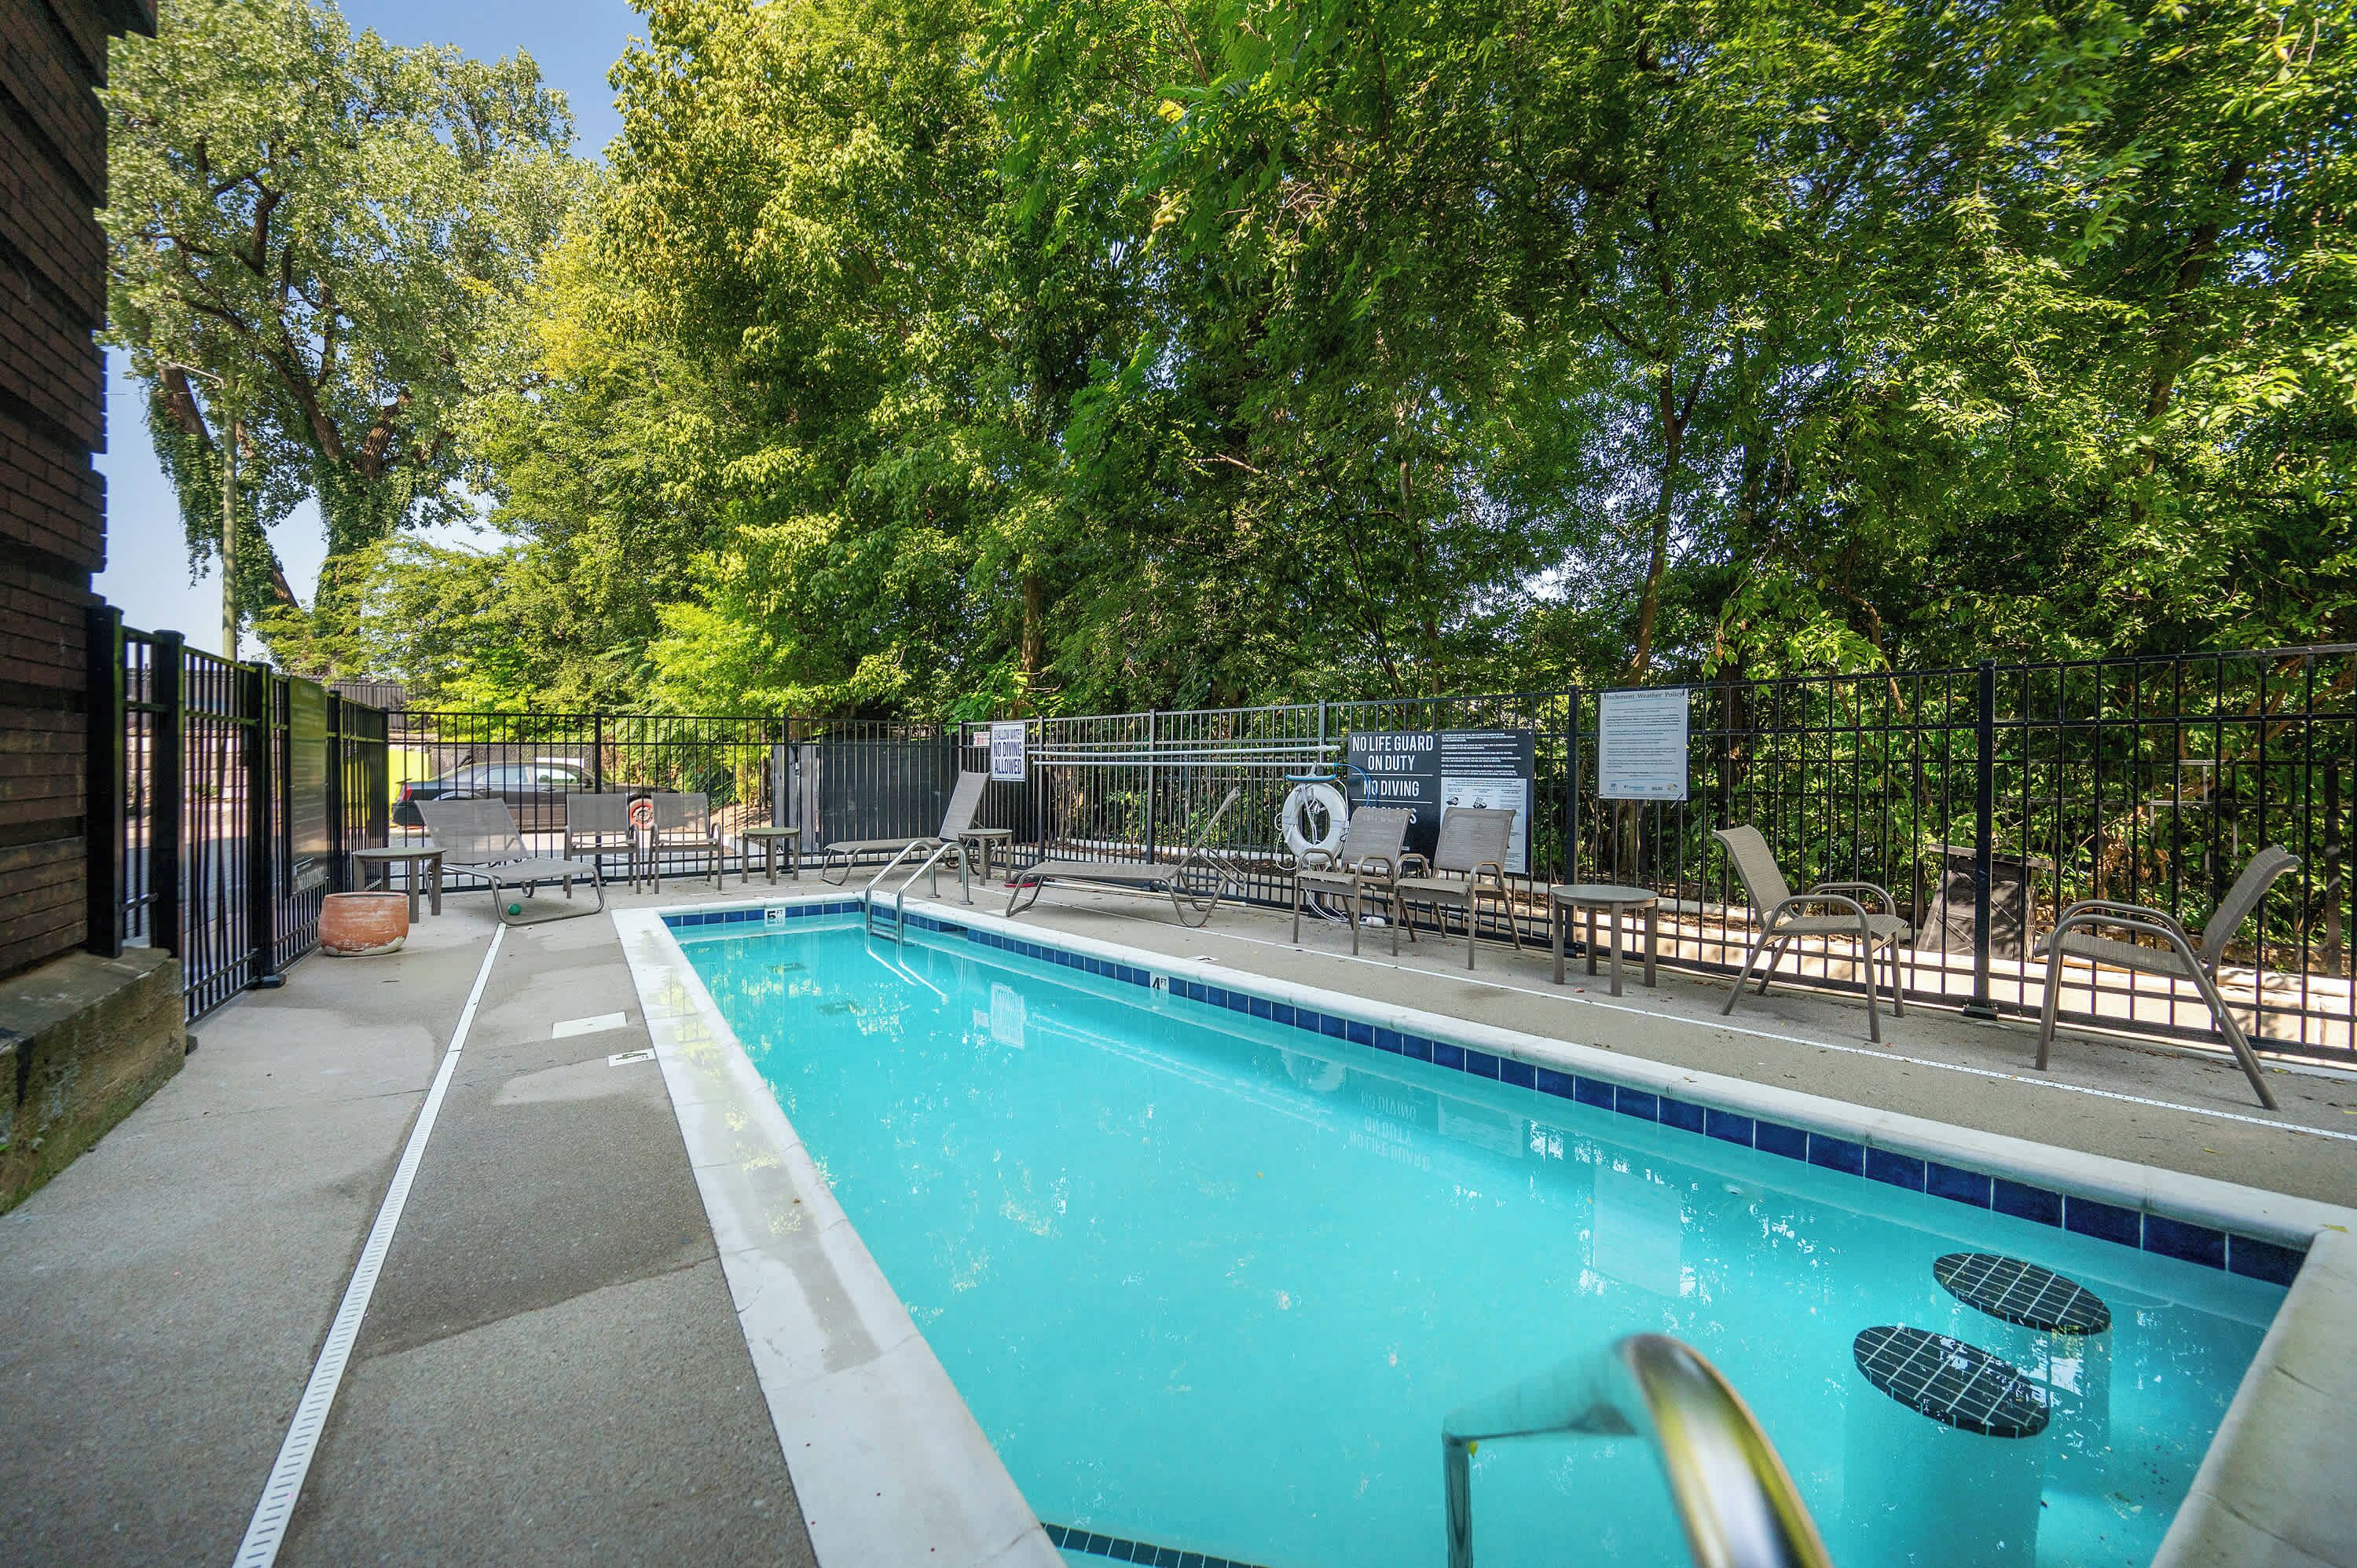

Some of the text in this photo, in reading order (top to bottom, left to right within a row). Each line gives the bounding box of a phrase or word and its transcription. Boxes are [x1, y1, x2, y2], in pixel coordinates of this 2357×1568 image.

[994, 741, 1022, 757] NO DIVING
[1352, 735, 1367, 752] NO
[1369, 735, 1391, 752] LIFE
[1394, 735, 1434, 752] GUARD
[995, 759, 1022, 774] ALLOWED
[1368, 755, 1415, 771] ON DUTY
[1363, 780, 1420, 797] NO DIVING
[1160, 978, 1168, 987] FT
